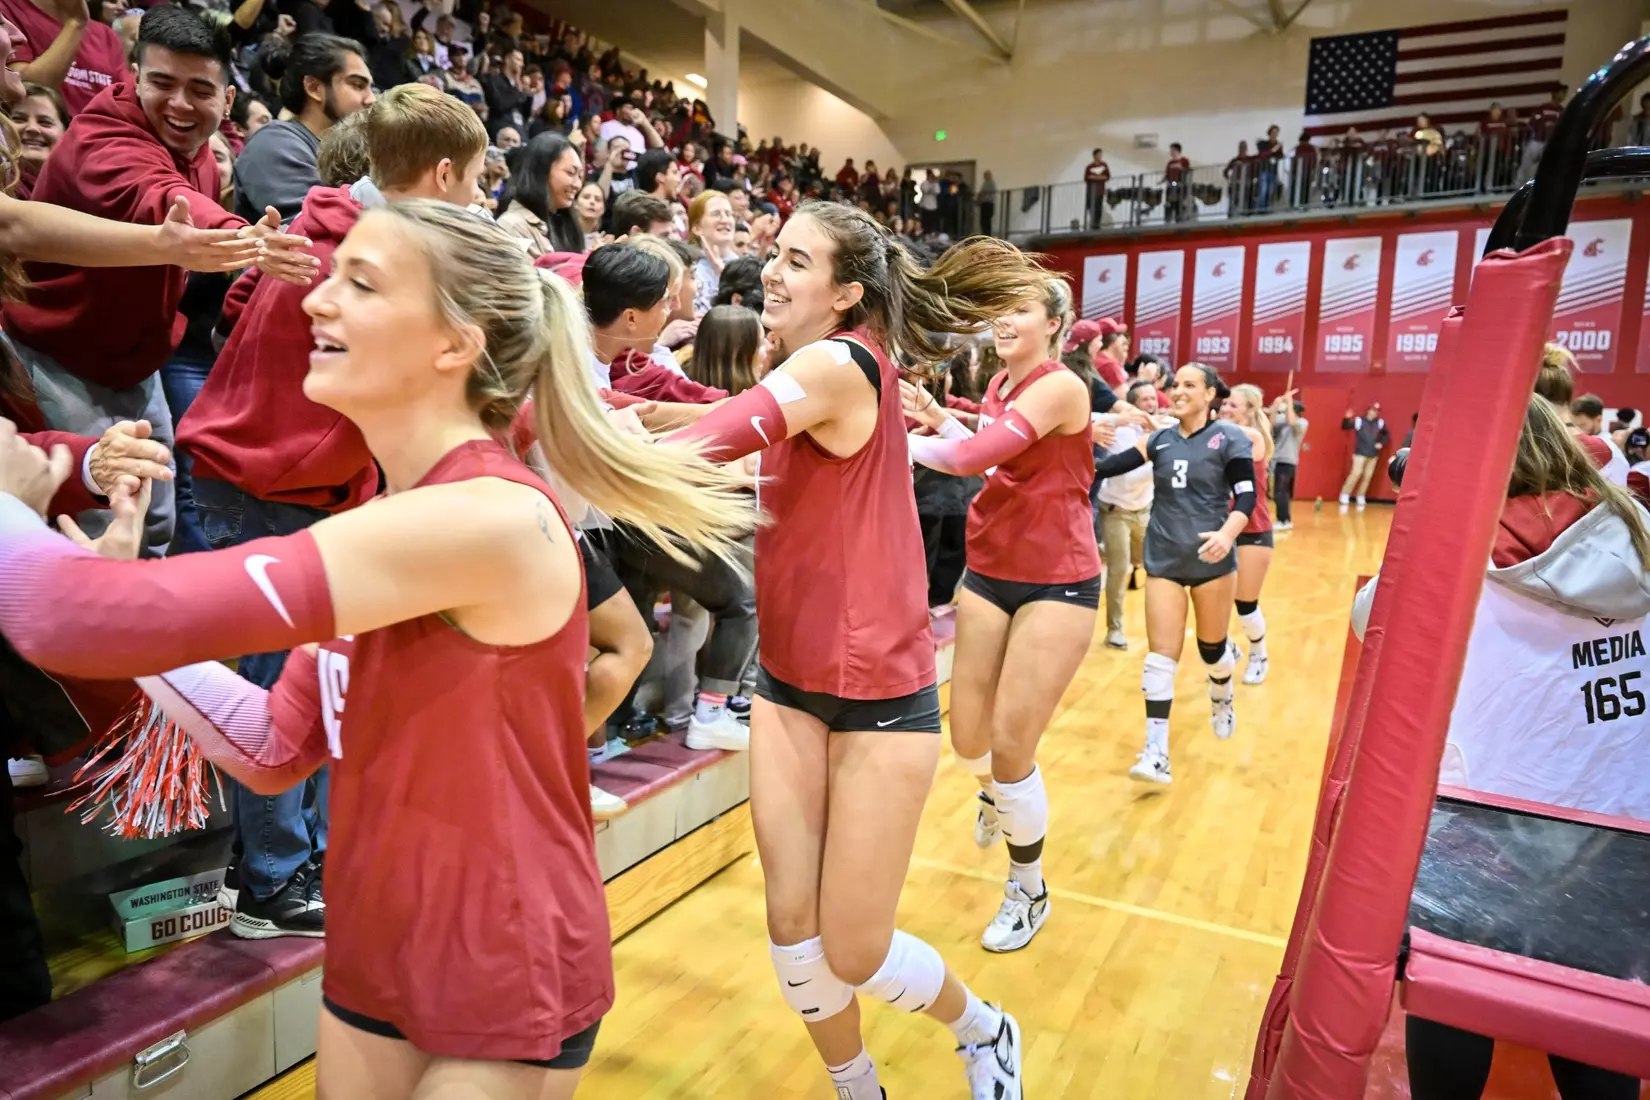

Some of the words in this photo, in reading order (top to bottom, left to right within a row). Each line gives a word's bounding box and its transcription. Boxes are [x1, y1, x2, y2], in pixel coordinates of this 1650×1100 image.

[88, 70, 112, 86] STATE
[1139, 337, 1171, 354] 1992
[1196, 336, 1231, 354] 1993
[1257, 336, 1294, 353] 1994
[1324, 333, 1364, 353] 1995
[1395, 332, 1438, 353] 1996
[1555, 330, 1611, 350] 2000
[1171, 459, 1188, 488] 3
[1571, 629, 1646, 669] MEDIA
[1580, 670, 1646, 724] 165
[130, 887, 191, 909] WASHINGTON
[193, 879, 219, 895] STATE
[151, 918, 176, 941] GO
[180, 906, 233, 933] COUG
